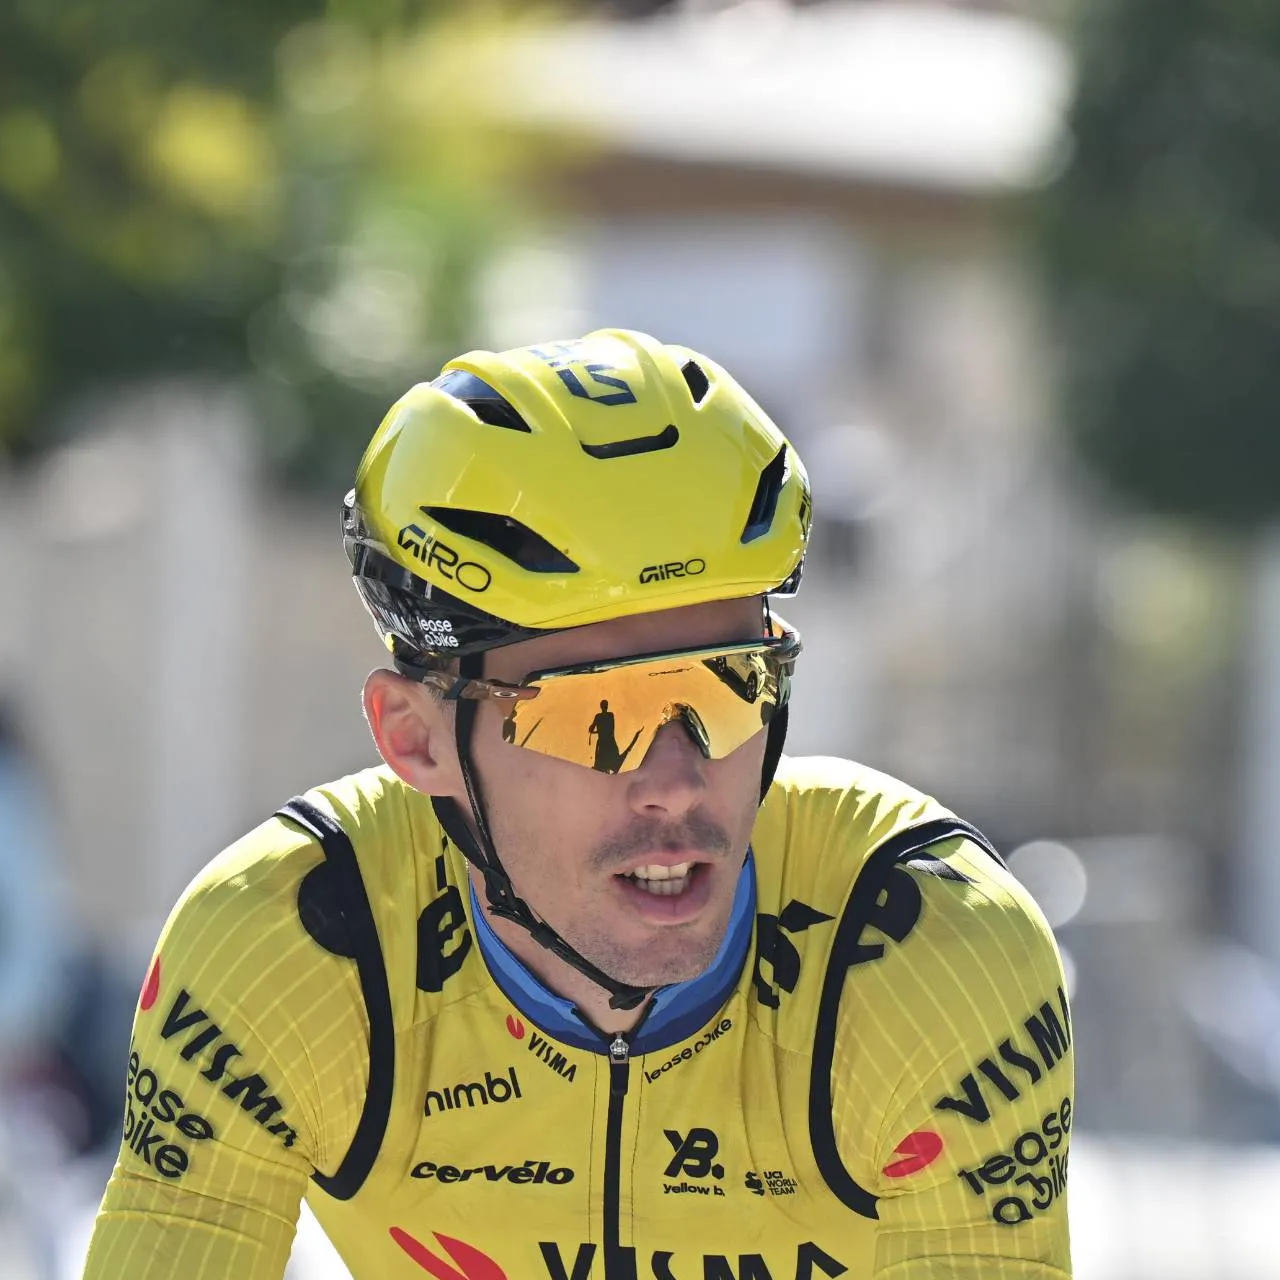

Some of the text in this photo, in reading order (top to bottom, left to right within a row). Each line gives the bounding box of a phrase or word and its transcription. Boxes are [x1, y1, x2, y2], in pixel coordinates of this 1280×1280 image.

[397, 523, 492, 592] GIRO
[638, 558, 706, 584] GIRO
[416, 616, 452, 632] lease
[527, 1031, 577, 1083] VISMA
[127, 1045, 214, 1140] ease
[424, 1067, 522, 1117] nimbl
[411, 1160, 575, 1185] cervélo
[764, 1171, 783, 1179] UCI
[663, 1183, 710, 1194] yellow
[769, 1187, 795, 1196] TEAM
